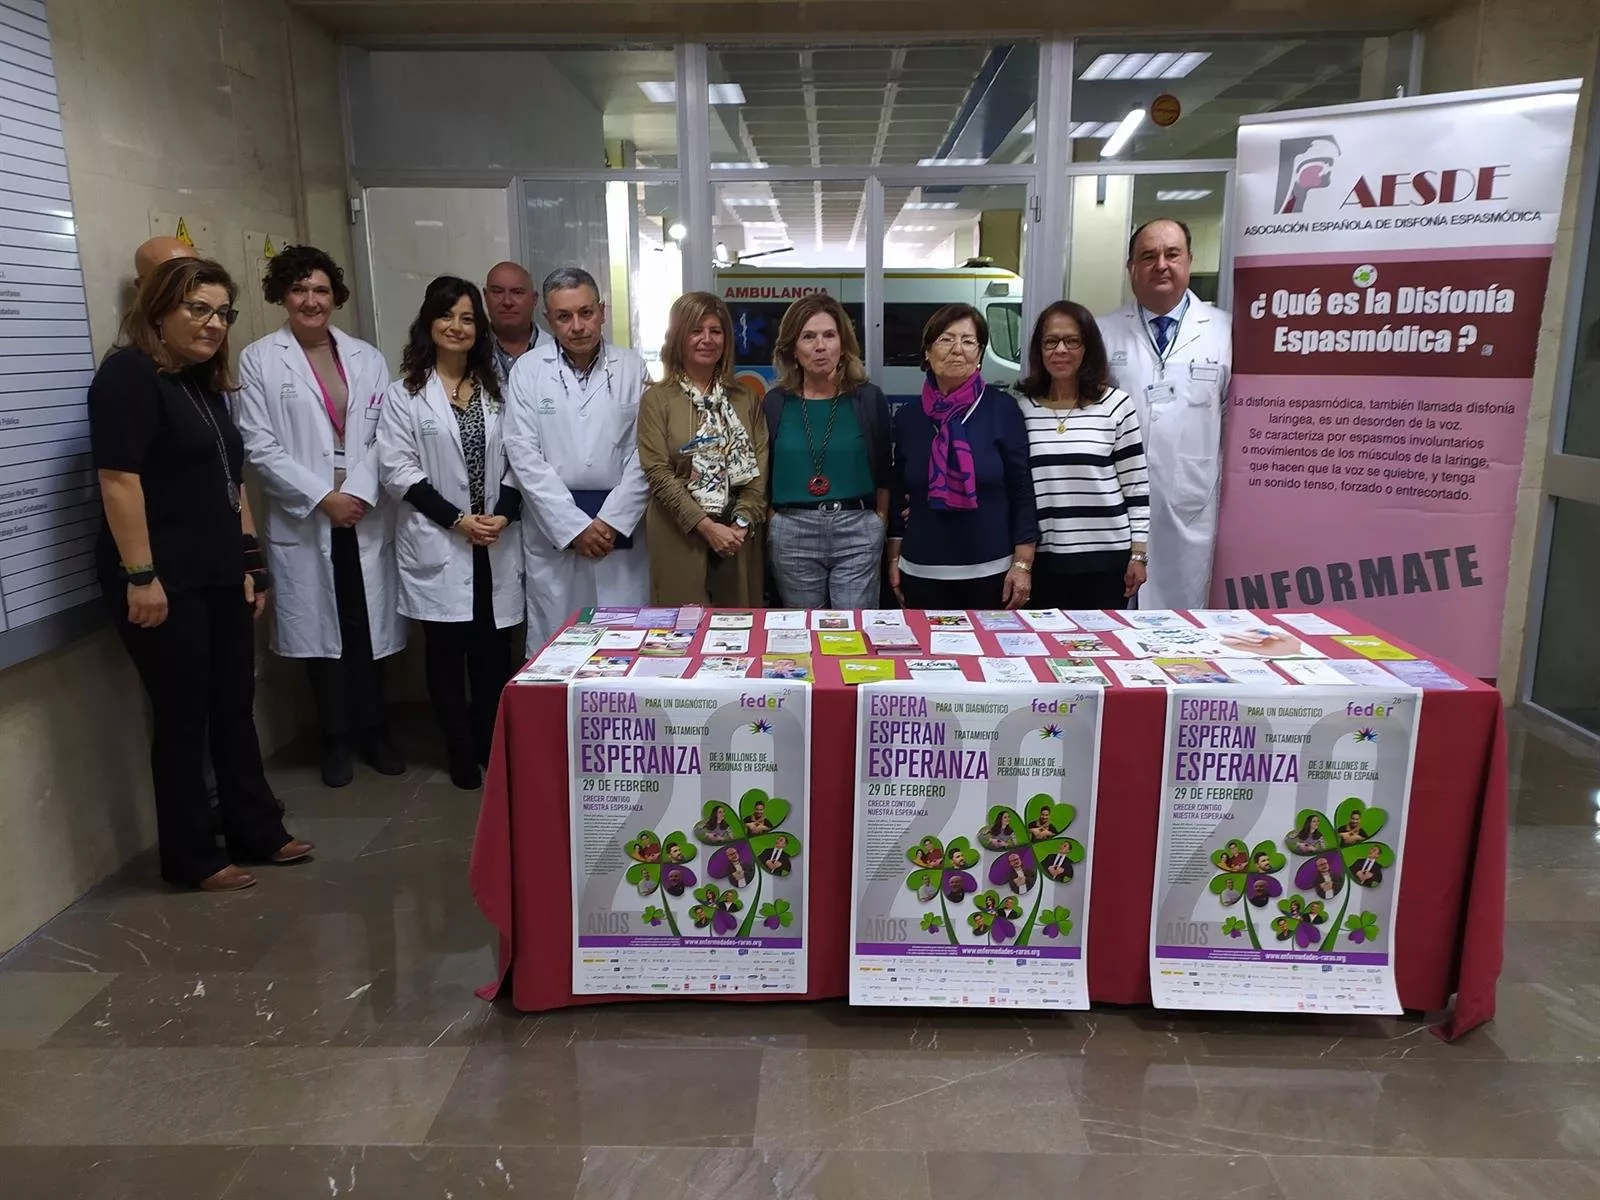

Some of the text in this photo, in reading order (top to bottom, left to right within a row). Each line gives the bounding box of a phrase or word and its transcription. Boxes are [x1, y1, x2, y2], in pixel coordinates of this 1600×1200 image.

[1339, 165, 1511, 210] AESDE
[1243, 210, 1541, 236] ASOCIACIÓN ESPAÑOLA DE DISFONÍA ESPASMÓDICA
[724, 286, 828, 298] AMBULANCIA
[1272, 288, 1322, 317] Qué
[1327, 294, 1359, 316] es
[1364, 288, 1392, 315] la
[1396, 284, 1514, 314] Disfonía
[1274, 325, 1452, 355] Espasmódica
[1234, 396, 1515, 414] La disfonía espasmódica, también llamada disfonía
[1269, 413, 1462, 430] laríngea, es un desorden de la voz.
[1249, 428, 1484, 449] Se caracteriza por espasmos involuntarios
[1242, 445, 1490, 469] o movimientos de los músculos de la laringe,
[1250, 462, 1475, 486] que hacen que la voz se quiebre, y tenga
[1249, 478, 1472, 500] un sonido tenso, forzado o entrecortado.
[1224, 545, 1483, 610] INFORMATE
[581, 691, 637, 713] ESPERA
[645, 697, 717, 709] PARA UN DIAGNÓSTICO
[740, 692, 784, 709] feder
[871, 695, 927, 717] ESPERA
[936, 701, 1008, 714] PARA UN DIAGNÓSTICO
[1031, 698, 1077, 713] feder
[1180, 699, 1238, 721] ESPERA
[1247, 705, 1323, 717] PARA UN DIAGNÓSTICO
[1346, 702, 1394, 717] feder
[581, 717, 655, 741] ESPERAN
[664, 726, 709, 736] TRATAMIENTO
[870, 721, 945, 745] ESPERAN
[954, 731, 999, 741] TRATAMIENTO
[1178, 725, 1256, 749] ESPERAN
[1265, 734, 1311, 744] TRATAMIENTO
[581, 744, 701, 774] ESPERANZA
[709, 752, 767, 762] DE 3 MILLONES DE
[868, 748, 989, 779] ESPERANZA
[998, 757, 1055, 767] DE 3 MILLONES DE
[1308, 760, 1368, 770] DE 3 MILLONES DE
[709, 763, 742, 772] PERSONAS
[744, 763, 752, 772] EN
[997, 768, 1029, 777] PERSONAS
[1031, 768, 1039, 776] EN
[1176, 752, 1299, 783] ESPERANZA
[1308, 771, 1341, 780] PERSONAS
[1344, 772, 1352, 780] EN
[583, 779, 659, 792] 29 DE FEBRERO
[868, 784, 945, 797] 29 DE FEBRERO
[1174, 788, 1253, 800] 29 DE FEBRERO
[583, 803, 644, 812] NUESTRA ESPERANZA
[891, 800, 915, 808] CONTIGO
[1197, 804, 1222, 812] CONTIGO
[895, 809, 928, 817] ESPERANZA
[588, 907, 629, 934] AÑOS
[865, 914, 907, 942] AÑOS
[1165, 917, 1209, 945] AÑOS
